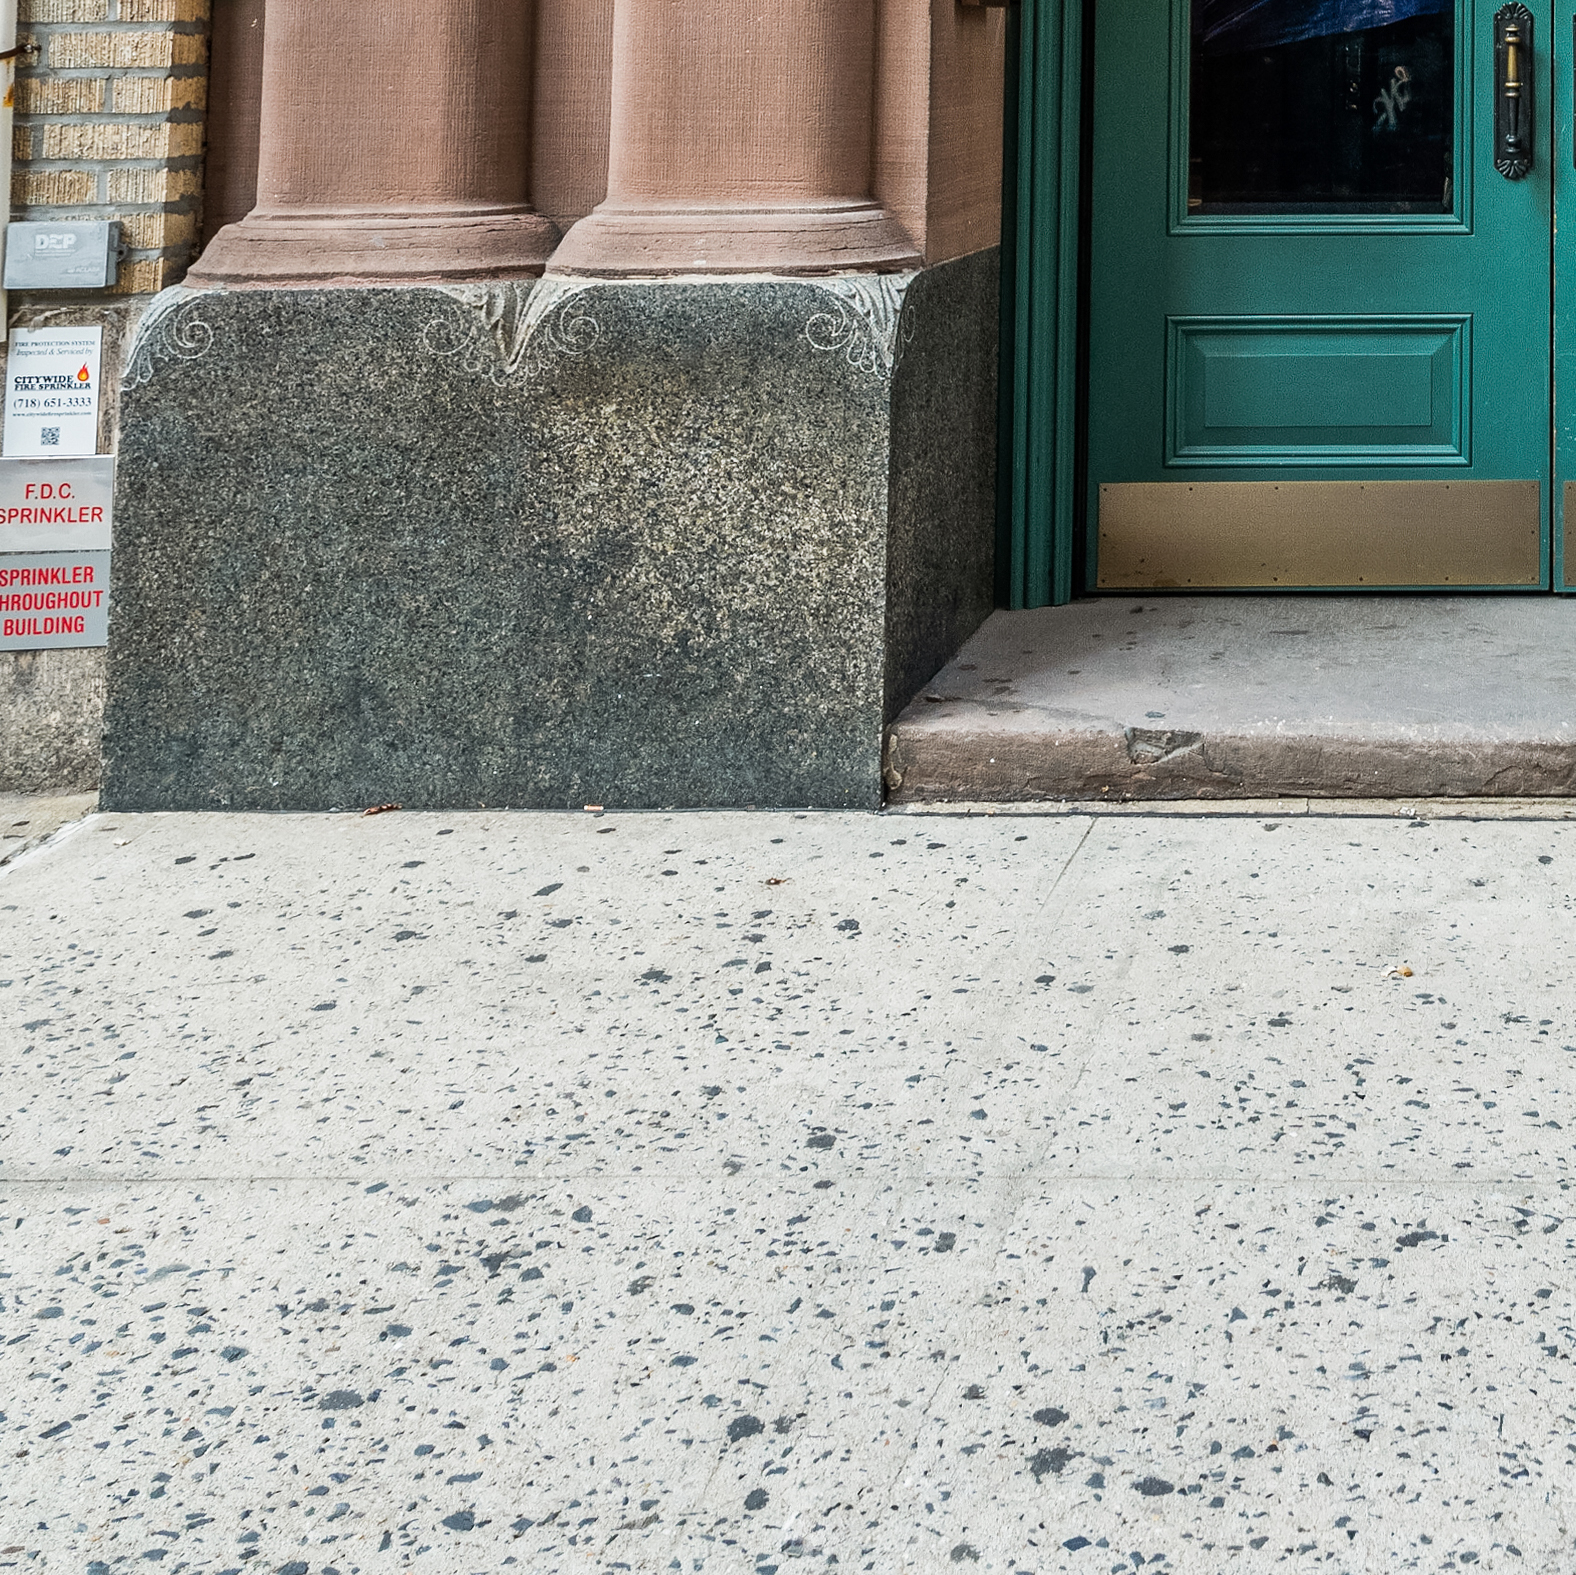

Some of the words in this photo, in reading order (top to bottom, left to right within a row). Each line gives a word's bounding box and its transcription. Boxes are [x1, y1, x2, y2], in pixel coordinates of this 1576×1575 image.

[35, 233, 77, 250] DEP
[16, 349, 47, 357] Inspected
[14, 375, 73, 383] CITYWIDE
[38, 382, 91, 390] SPRINKLER
[13, 398, 41, 409] (718)
[43, 397, 92, 408] 651-3333
[25, 483, 76, 500] F.D.C.
[0, 506, 104, 524] SPRINKLER
[0, 566, 94, 587] SPRINKLER
[0, 590, 104, 612] HROUGHOUT
[3, 616, 85, 637] BUILDING
